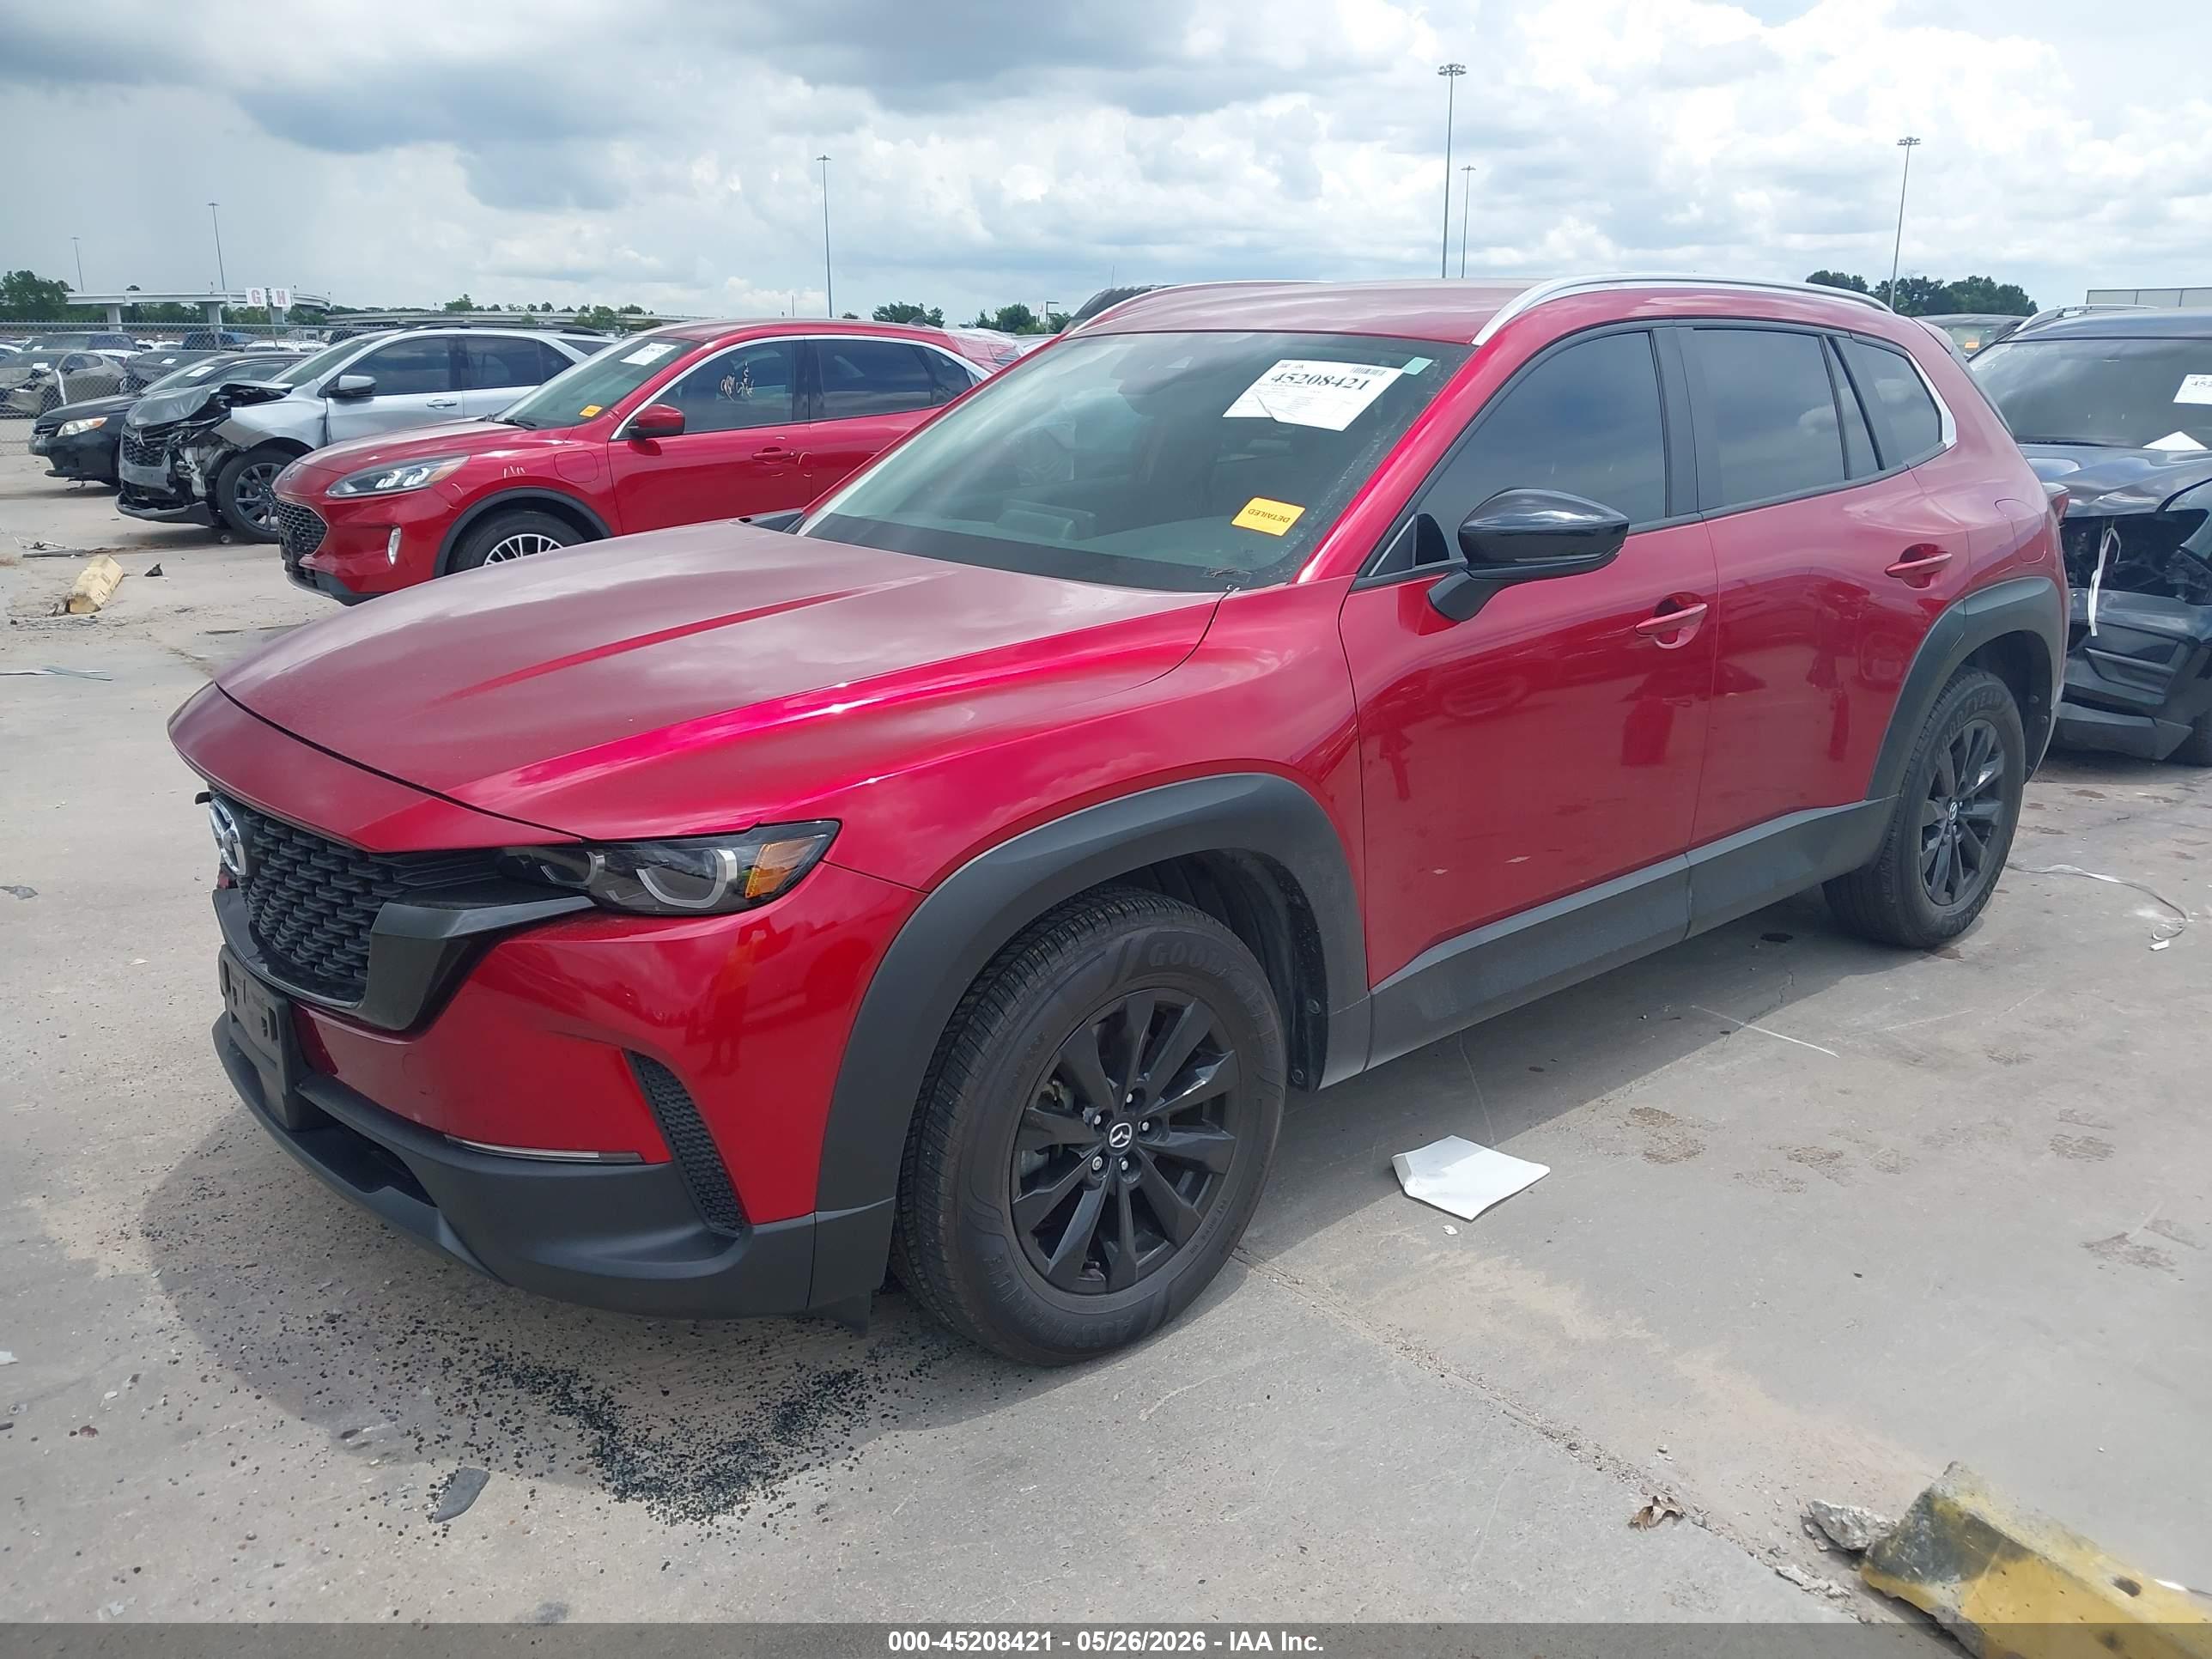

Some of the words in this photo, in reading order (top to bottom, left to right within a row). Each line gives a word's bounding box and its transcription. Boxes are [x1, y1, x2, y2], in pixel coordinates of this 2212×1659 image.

[251, 289, 262, 305] G
[276, 290, 287, 305] H
[1270, 373, 1370, 390] 45208421
[1248, 508, 1291, 523] DETAILED
